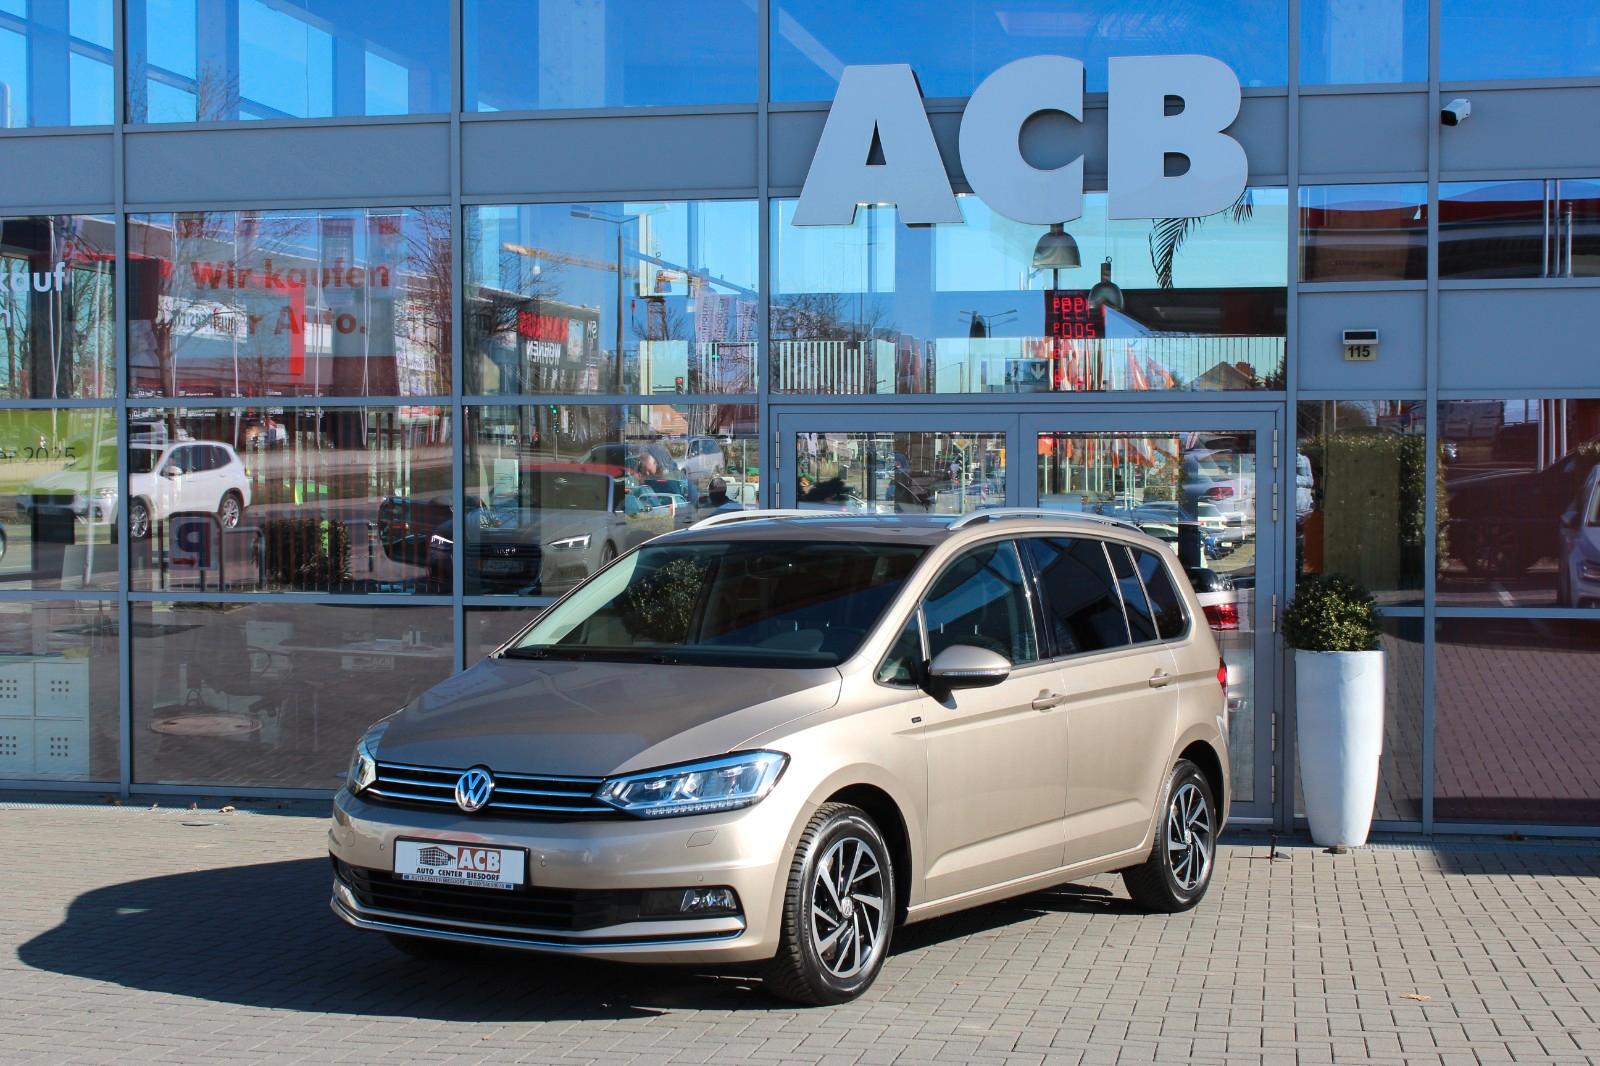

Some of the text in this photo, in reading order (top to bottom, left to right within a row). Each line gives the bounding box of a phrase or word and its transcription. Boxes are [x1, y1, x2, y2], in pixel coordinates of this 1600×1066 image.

[791, 54, 1249, 227] ACB
[191, 258, 390, 290] Wir kaufen
[1348, 345, 1370, 358] 115
[23, 446, 76, 468] 2025
[459, 848, 500, 873] ACB
[416, 867, 434, 875] AUTO
[438, 869, 462, 878] CENTER
[466, 872, 500, 881] BIESDORF
